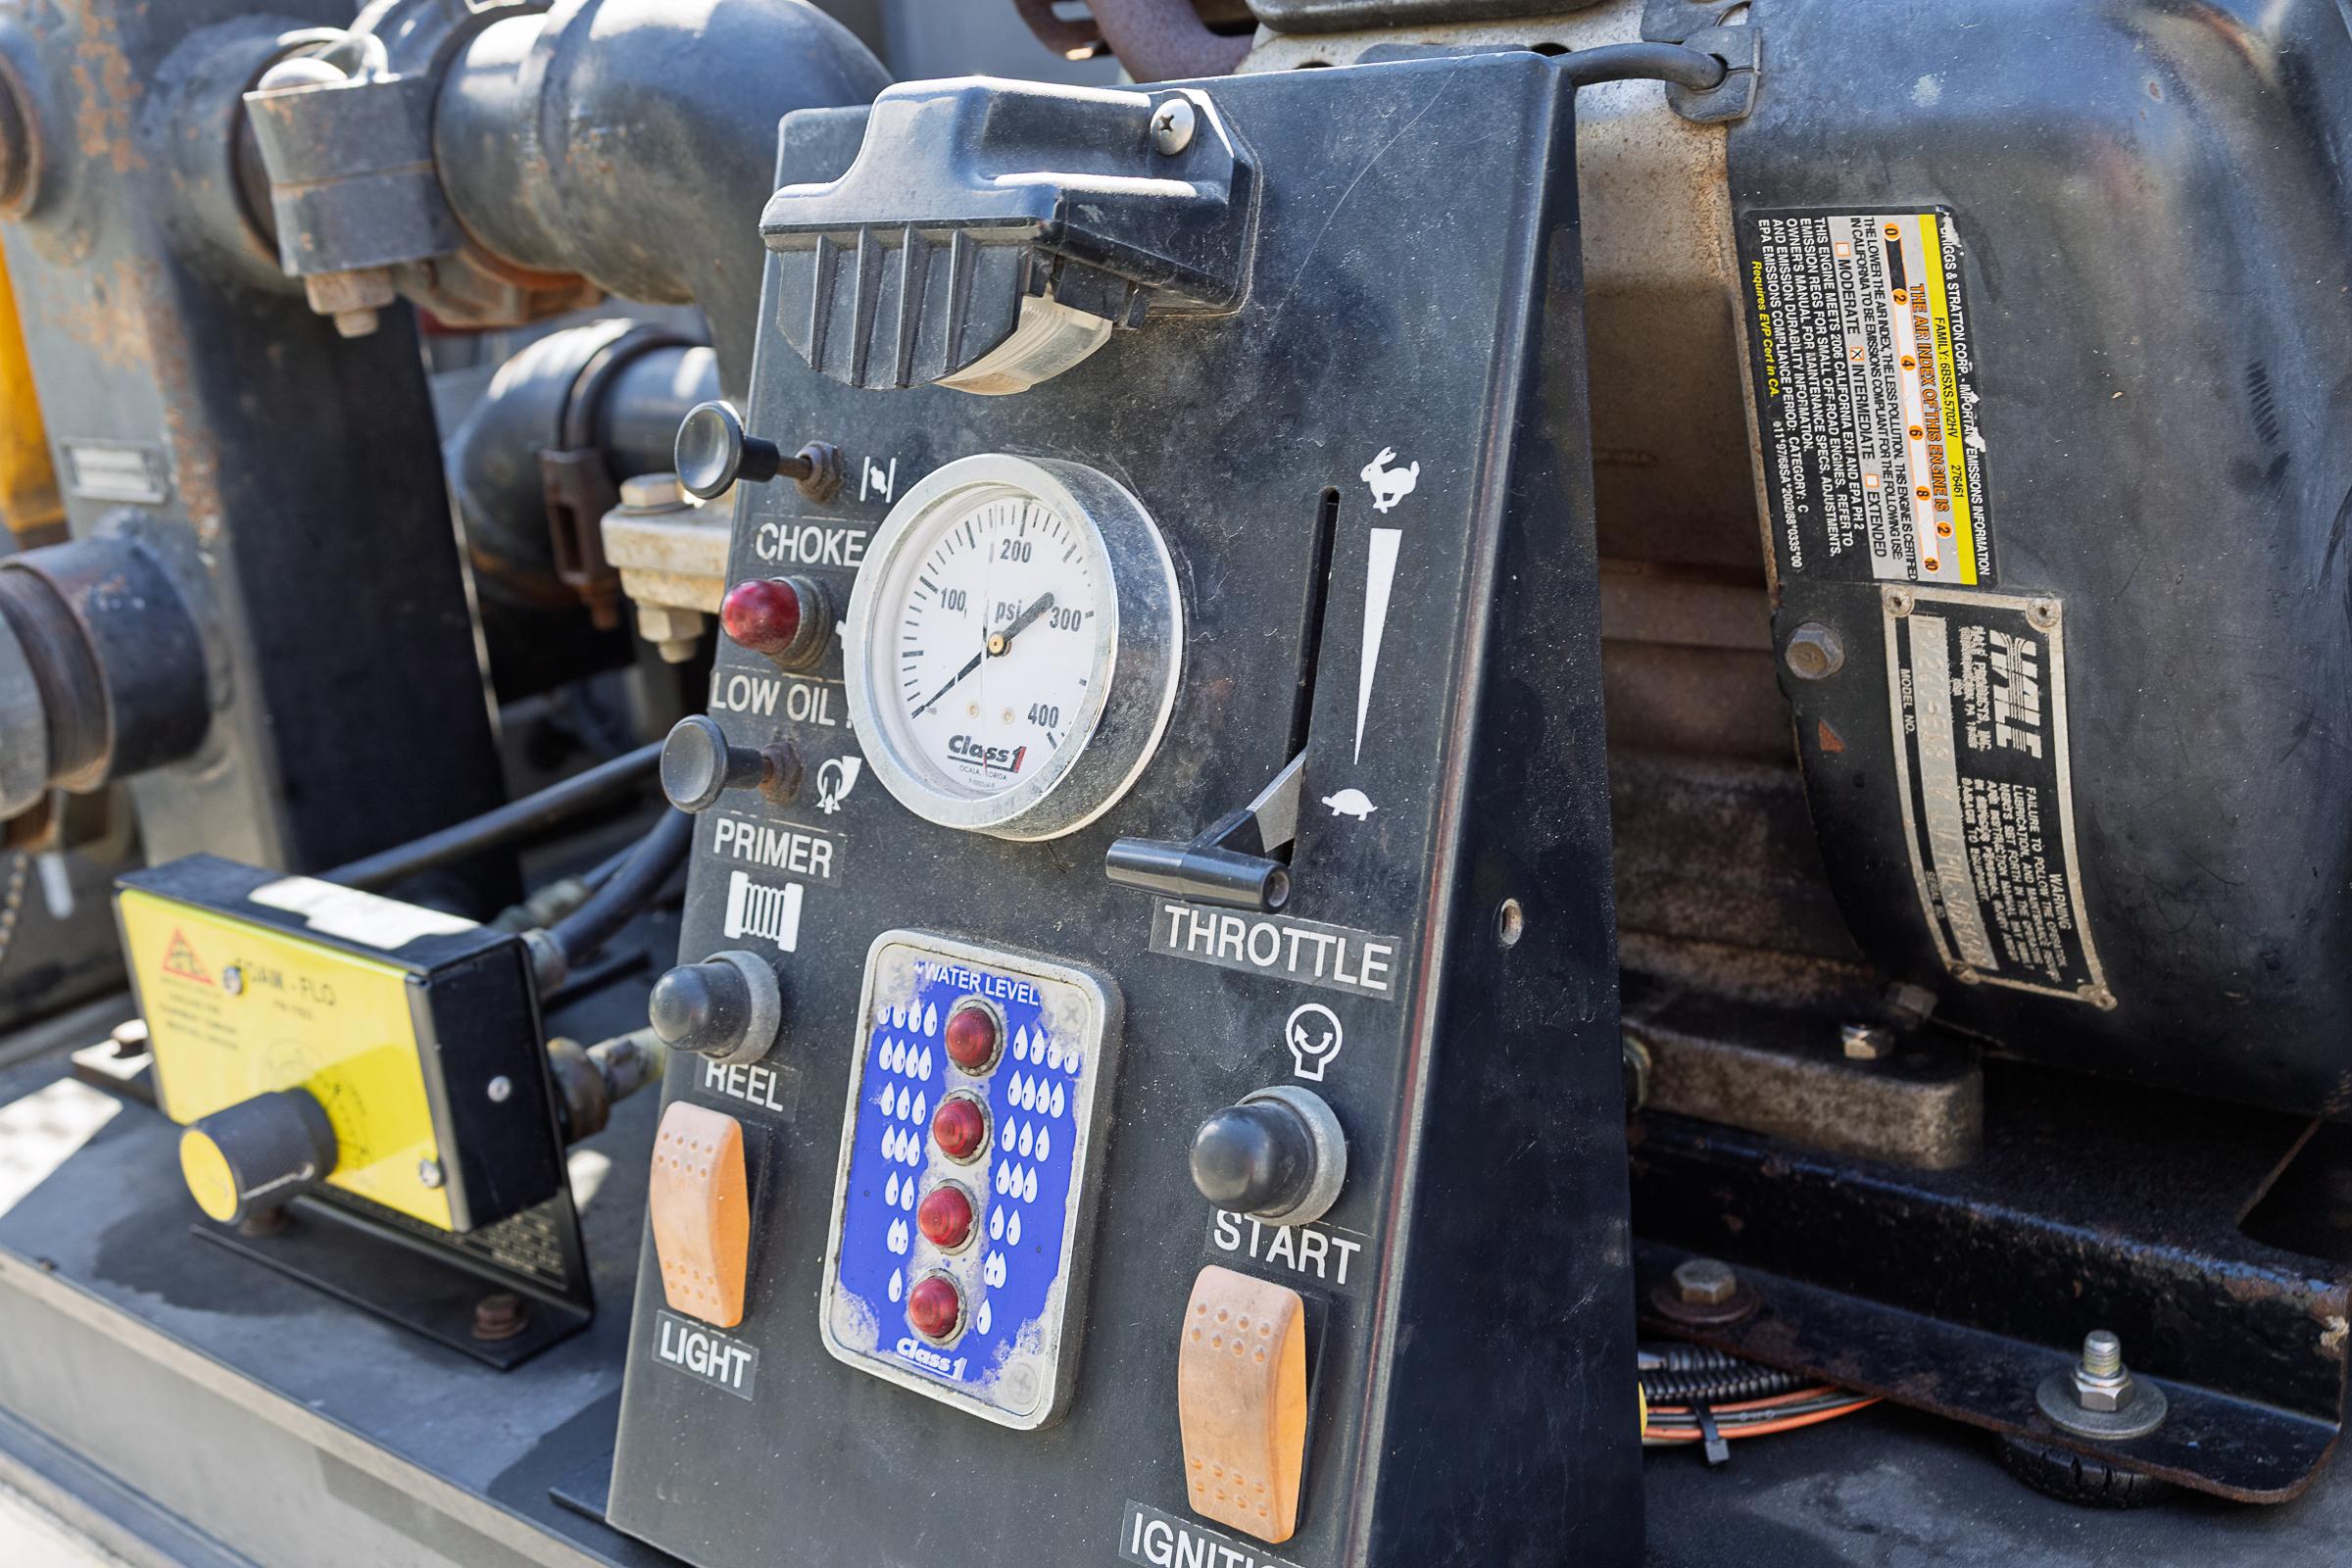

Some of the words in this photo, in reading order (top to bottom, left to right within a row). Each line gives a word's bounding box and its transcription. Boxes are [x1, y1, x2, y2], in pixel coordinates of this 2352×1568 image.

[1757, 219, 1772, 242] EPA
[1771, 219, 1786, 242] AND
[1814, 218, 1829, 243] THIS
[1850, 218, 1862, 226] IN
[1863, 217, 1877, 237] THE
[1786, 218, 1803, 271] OWNER'S
[1799, 218, 1818, 272] EMISSION
[1852, 229, 1870, 290] CALIFORNIA
[1866, 239, 1882, 276] LOWER
[1761, 245, 1781, 307] EMISSIONS
[1775, 246, 1793, 300] EMISSION
[1818, 246, 1835, 289] ENGINE
[1749, 261, 1767, 310] Requires
[1793, 274, 1810, 322] MANUAL
[1807, 275, 1823, 308] REGS
[1859, 292, 1872, 305] TO
[1871, 278, 1885, 298] THE
[1908, 283, 1927, 313] THE
[1757, 314, 1771, 336] EVP
[1812, 311, 1826, 333] FOR
[1824, 292, 1839, 330] MEETS
[1861, 308, 1874, 321] BE
[1874, 301, 1886, 318] AIR
[1946, 282, 1965, 340] STRATTON
[1783, 304, 1802, 369] DURABILITY
[1799, 325, 1814, 349] FOR
[1875, 319, 1890, 351] INDEX,
[1912, 316, 1930, 339] AIR
[1761, 339, 1775, 363] Cert
[1770, 310, 1790, 383] COMPLIANCE
[1815, 337, 1831, 374] SMALL
[1829, 333, 1843, 358] 2006
[1864, 324, 1881, 376] EMISSIONS
[1880, 353, 1893, 373] THE
[1953, 343, 1969, 375] CORP.
[1764, 365, 1777, 373] in
[1915, 343, 1936, 385] INDEX
[1766, 378, 1780, 397] CA.
[1803, 352, 1825, 432] MAINTENANCE
[1833, 361, 1852, 428] CALIFORNIA
[1883, 375, 1896, 400] LESS
[1921, 389, 1938, 408] OF
[1780, 386, 1797, 430] PERIOD:
[1791, 372, 1813, 452] INFORMATION.
[1820, 377, 1838, 434] OFF-ROAD
[1838, 259, 1859, 334] MODERATE
[1850, 365, 1875, 459] INTERMEDIATE
[1867, 491, 1886, 557] EXTENDED
[1870, 378, 1887, 435] COMPLIANT
[1934, 318, 1948, 360] FAMILY:
[1951, 465, 1965, 498] 276461
[1841, 431, 1855, 453] EXH
[1886, 402, 1904, 459] POLLUTION.
[1924, 411, 1942, 441] THIS
[1828, 437, 1845, 488] ENGINES.
[1878, 437, 1890, 458] FOR
[1787, 436, 1806, 499] CATEGORY:
[1844, 457, 1858, 479] AND
[1881, 460, 1893, 478] THE
[1893, 464, 1907, 484] THIS
[1928, 444, 1948, 495] ENGINE
[1965, 447, 1984, 504] EMISSIONS
[1848, 482, 1862, 504] EPA
[1883, 481, 1900, 537] FOLLOWING
[1896, 486, 1911, 521] ENGINE
[1934, 498, 1950, 512] IS
[1820, 476, 1840, 557] ADJUSTMENTS,
[1836, 494, 1851, 529] REFER
[1851, 506, 1864, 520] PH
[756, 522, 867, 568] CHOKE
[1001, 538, 1032, 563] 200
[1840, 531, 1853, 546] TO
[1890, 539, 1903, 560] USE:
[1972, 506, 1991, 575] INFORMATION
[1902, 533, 1919, 581] CERTIFIED
[1924, 559, 1938, 570] 10
[941, 588, 966, 612] 100
[995, 600, 1022, 623] psi
[1050, 606, 1081, 632] 300
[710, 671, 781, 717] LOW
[787, 683, 836, 727] OIL
[1899, 668, 1913, 710] MODEL
[1987, 629, 2042, 759] HALE
[1028, 703, 1058, 728] 400
[1903, 714, 1916, 734] NO.
[2025, 786, 2039, 833] FAILURE
[713, 817, 834, 878] PRIMER
[1967, 828, 1979, 843] TO
[2012, 784, 2030, 858] LUBRICATION,
[2022, 862, 2034, 883] AND
[2030, 836, 2042, 852] TO
[2007, 849, 2022, 882] FORTH
[2033, 856, 2050, 897] FOLLOW
[2013, 885, 2025, 896] IN
[2048, 872, 2071, 929] WARNING
[2040, 901, 2054, 918] THE
[1164, 905, 1394, 991] THROTTLE
[922, 961, 981, 993] WATER
[985, 977, 1039, 1006] LEVEL
[706, 1061, 783, 1112] REEL
[1213, 1209, 1361, 1285] START
[660, 1320, 752, 1389] LIGHT
[1131, 1512, 1275, 1568] IGNIT
